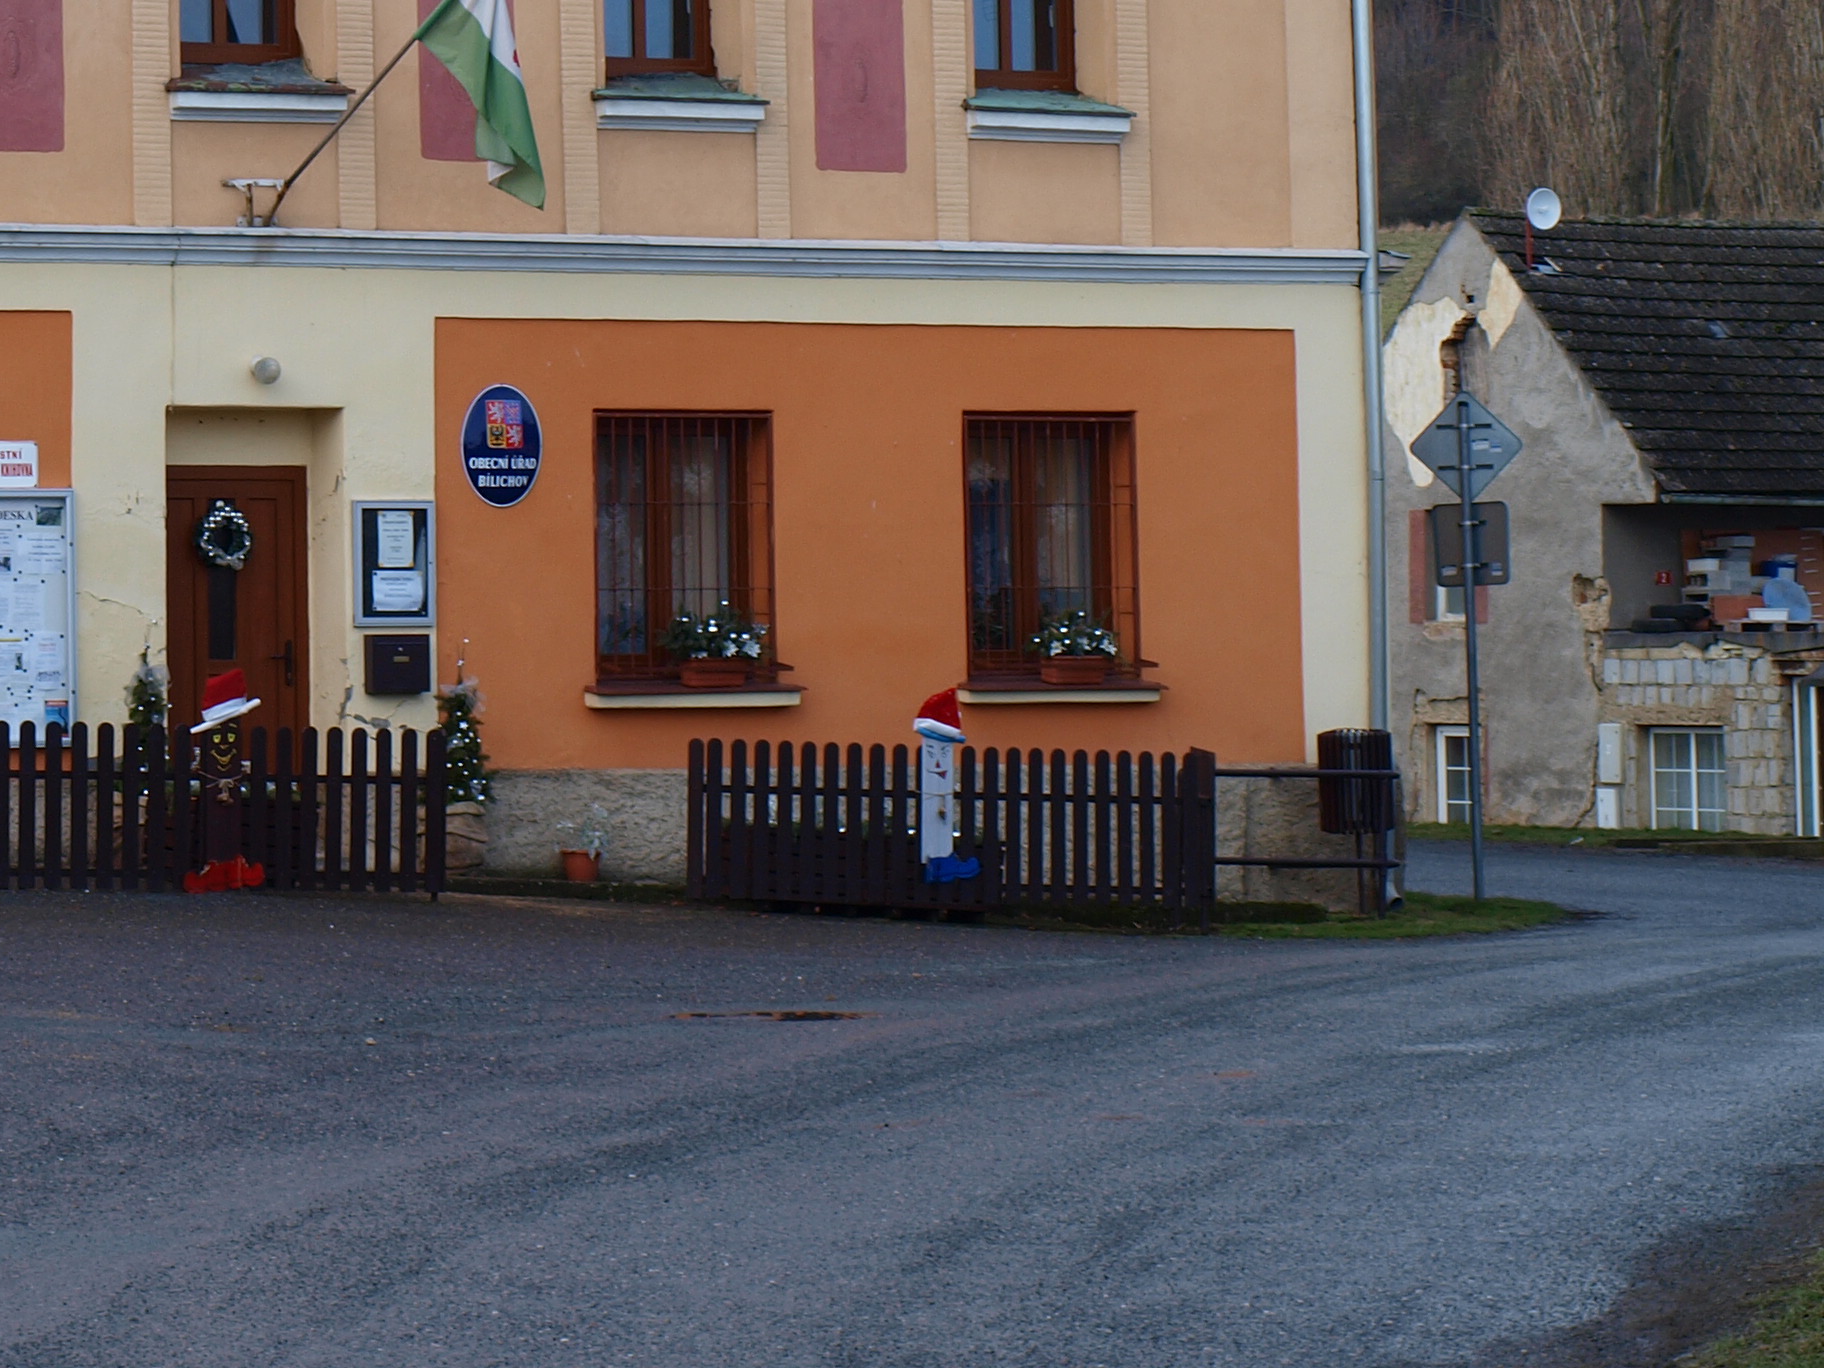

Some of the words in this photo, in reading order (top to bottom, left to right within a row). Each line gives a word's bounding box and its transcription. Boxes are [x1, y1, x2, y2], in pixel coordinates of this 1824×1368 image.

[1, 463, 34, 477] KNIHOVNA
[469, 455, 509, 470] OBECNÍ
[511, 455, 537, 470] ÚŘAD
[478, 473, 529, 488] BÍLICHOV
